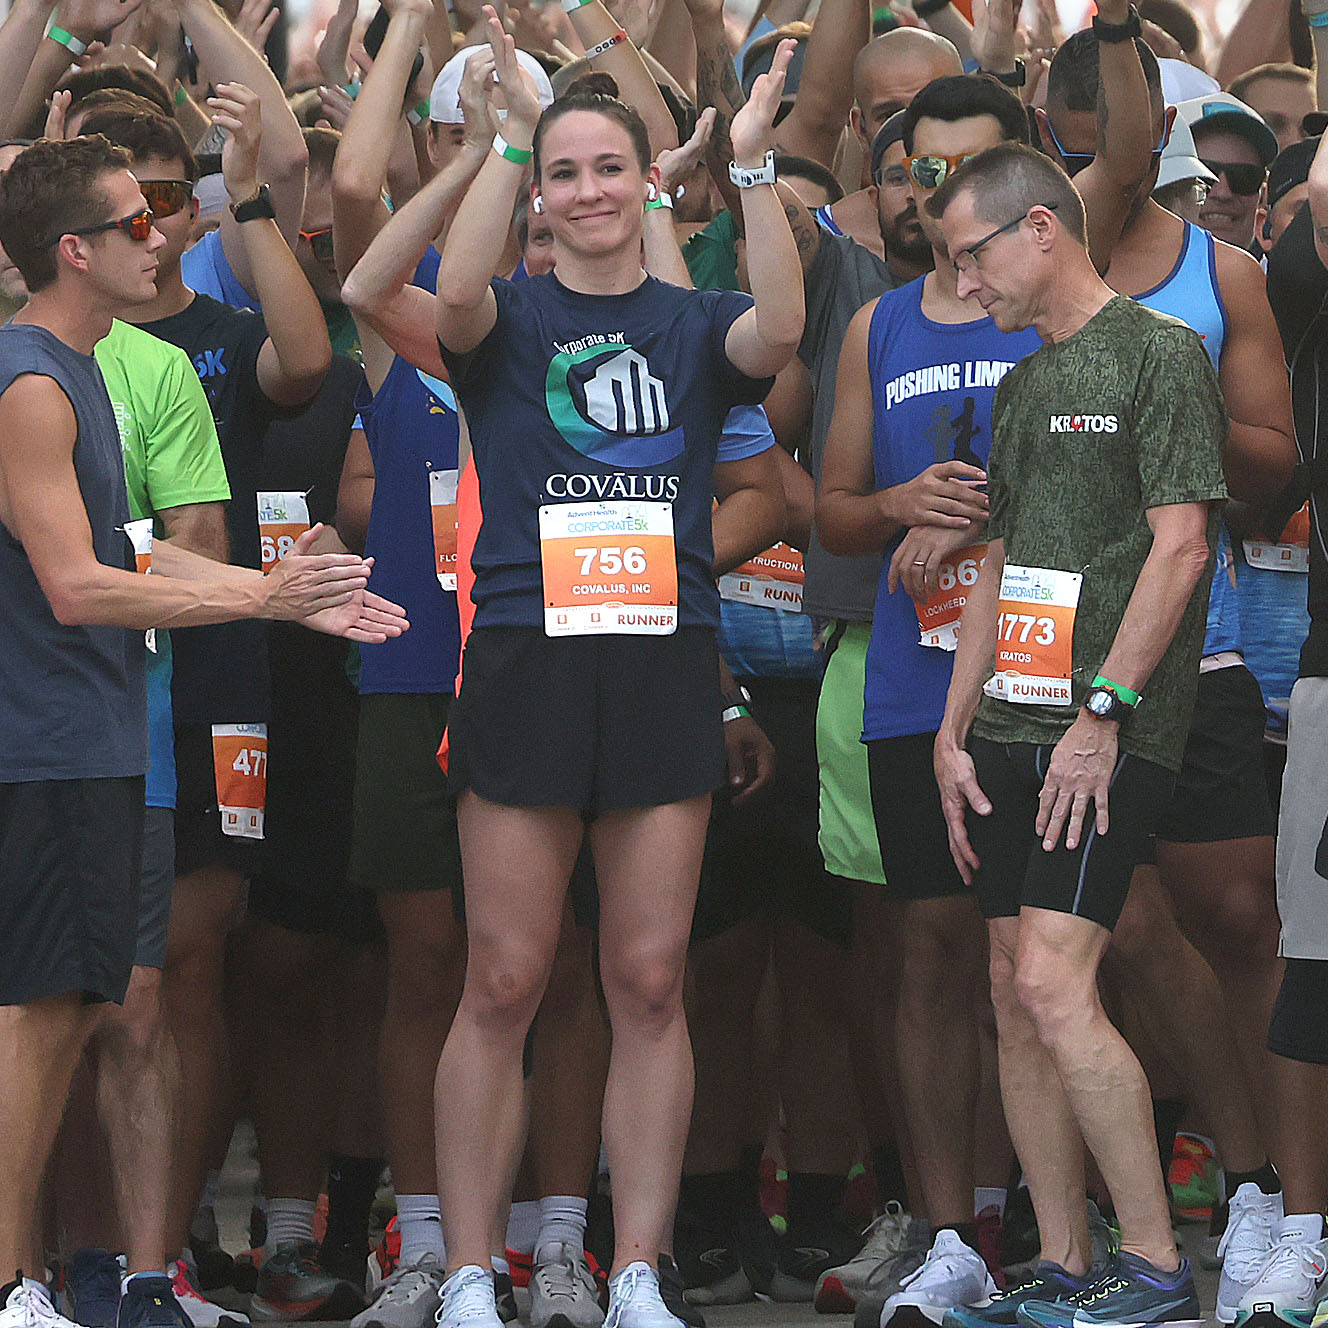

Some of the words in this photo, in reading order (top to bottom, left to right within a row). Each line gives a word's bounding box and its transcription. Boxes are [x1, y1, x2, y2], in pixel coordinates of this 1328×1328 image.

[885, 363, 961, 410] PUSHING
[1049, 414, 1119, 433] KRATOS
[567, 520, 634, 533] CORPORATE
[574, 546, 647, 576] 756
[749, 557, 799, 571] TRUCTION
[572, 583, 630, 595] COVALUS,
[631, 583, 651, 594] INC
[618, 614, 674, 626] RUNNER
[1012, 683, 1069, 699] RUNNER
